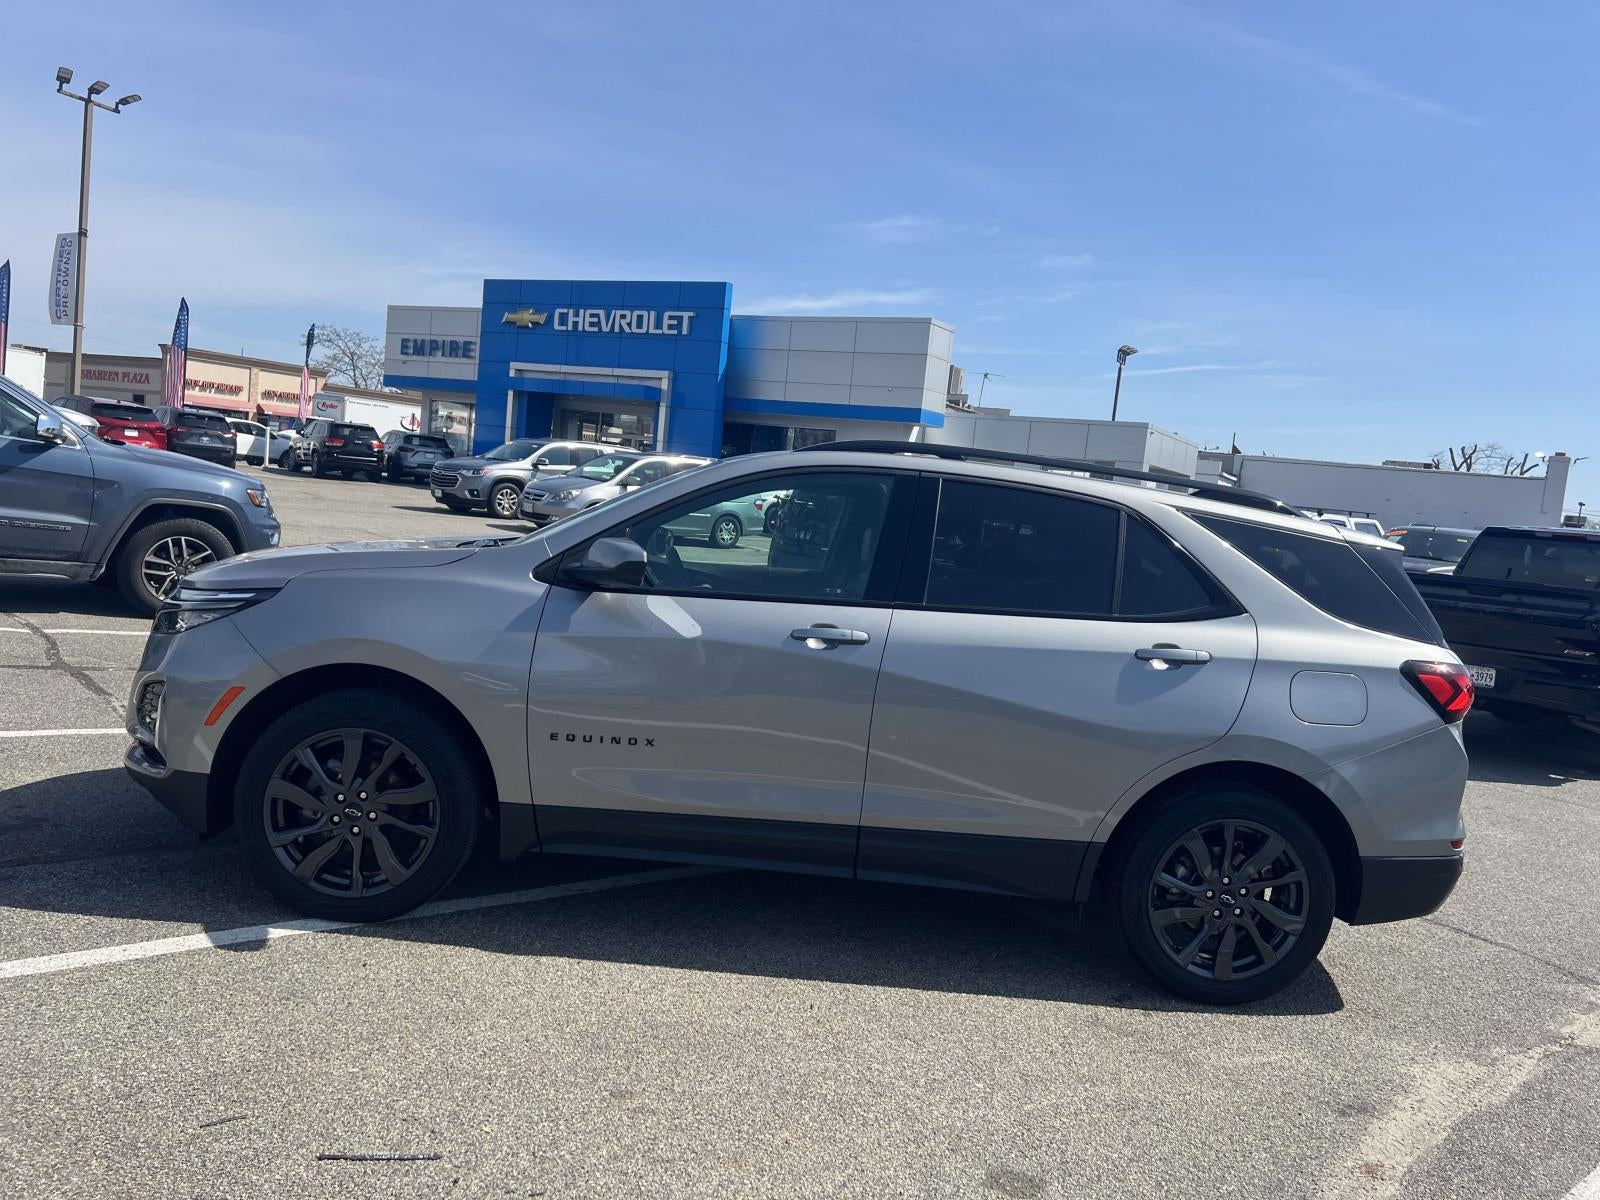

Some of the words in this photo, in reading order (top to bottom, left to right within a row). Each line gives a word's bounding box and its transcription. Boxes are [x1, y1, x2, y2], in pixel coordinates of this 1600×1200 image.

[55, 237, 67, 320] CERTIFIED
[61, 240, 73, 317] PRE-OWNED
[553, 308, 696, 335] CHEVROLET
[400, 338, 477, 359] EMPIRE
[81, 369, 120, 381] SHAHEEN
[122, 371, 151, 385] PLAZA
[321, 401, 339, 410] Ryder
[1474, 671, 1494, 683] 3979
[549, 732, 655, 747] EQUINOX
